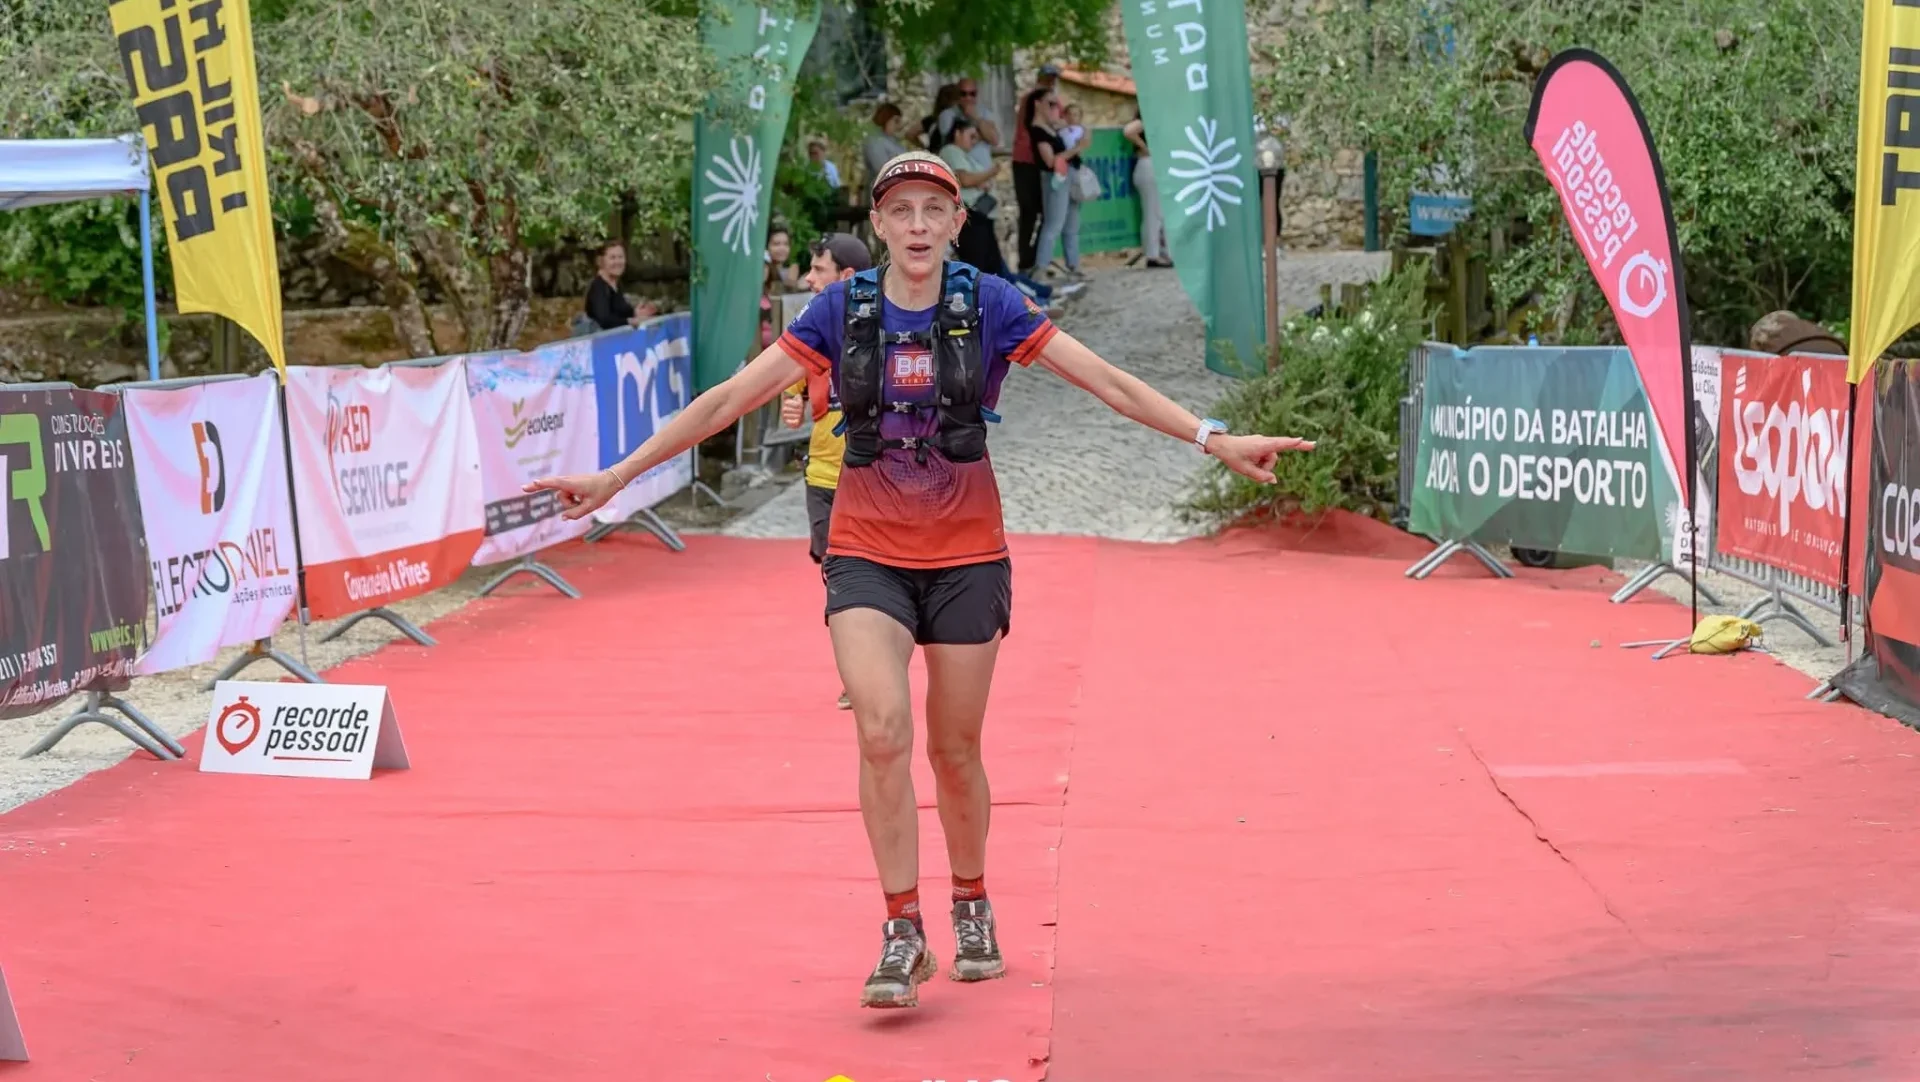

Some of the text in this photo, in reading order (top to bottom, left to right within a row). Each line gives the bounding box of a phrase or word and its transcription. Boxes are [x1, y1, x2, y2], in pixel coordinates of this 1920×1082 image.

[1514, 407, 1545, 443] DA
[1551, 408, 1648, 449] BATALHA
[340, 461, 408, 516] SERVICE
[1425, 447, 1647, 509] AOIA O DESPORTO
[397, 557, 430, 590] Pires
[272, 702, 369, 730] recorde
[263, 726, 369, 756] pessoal
